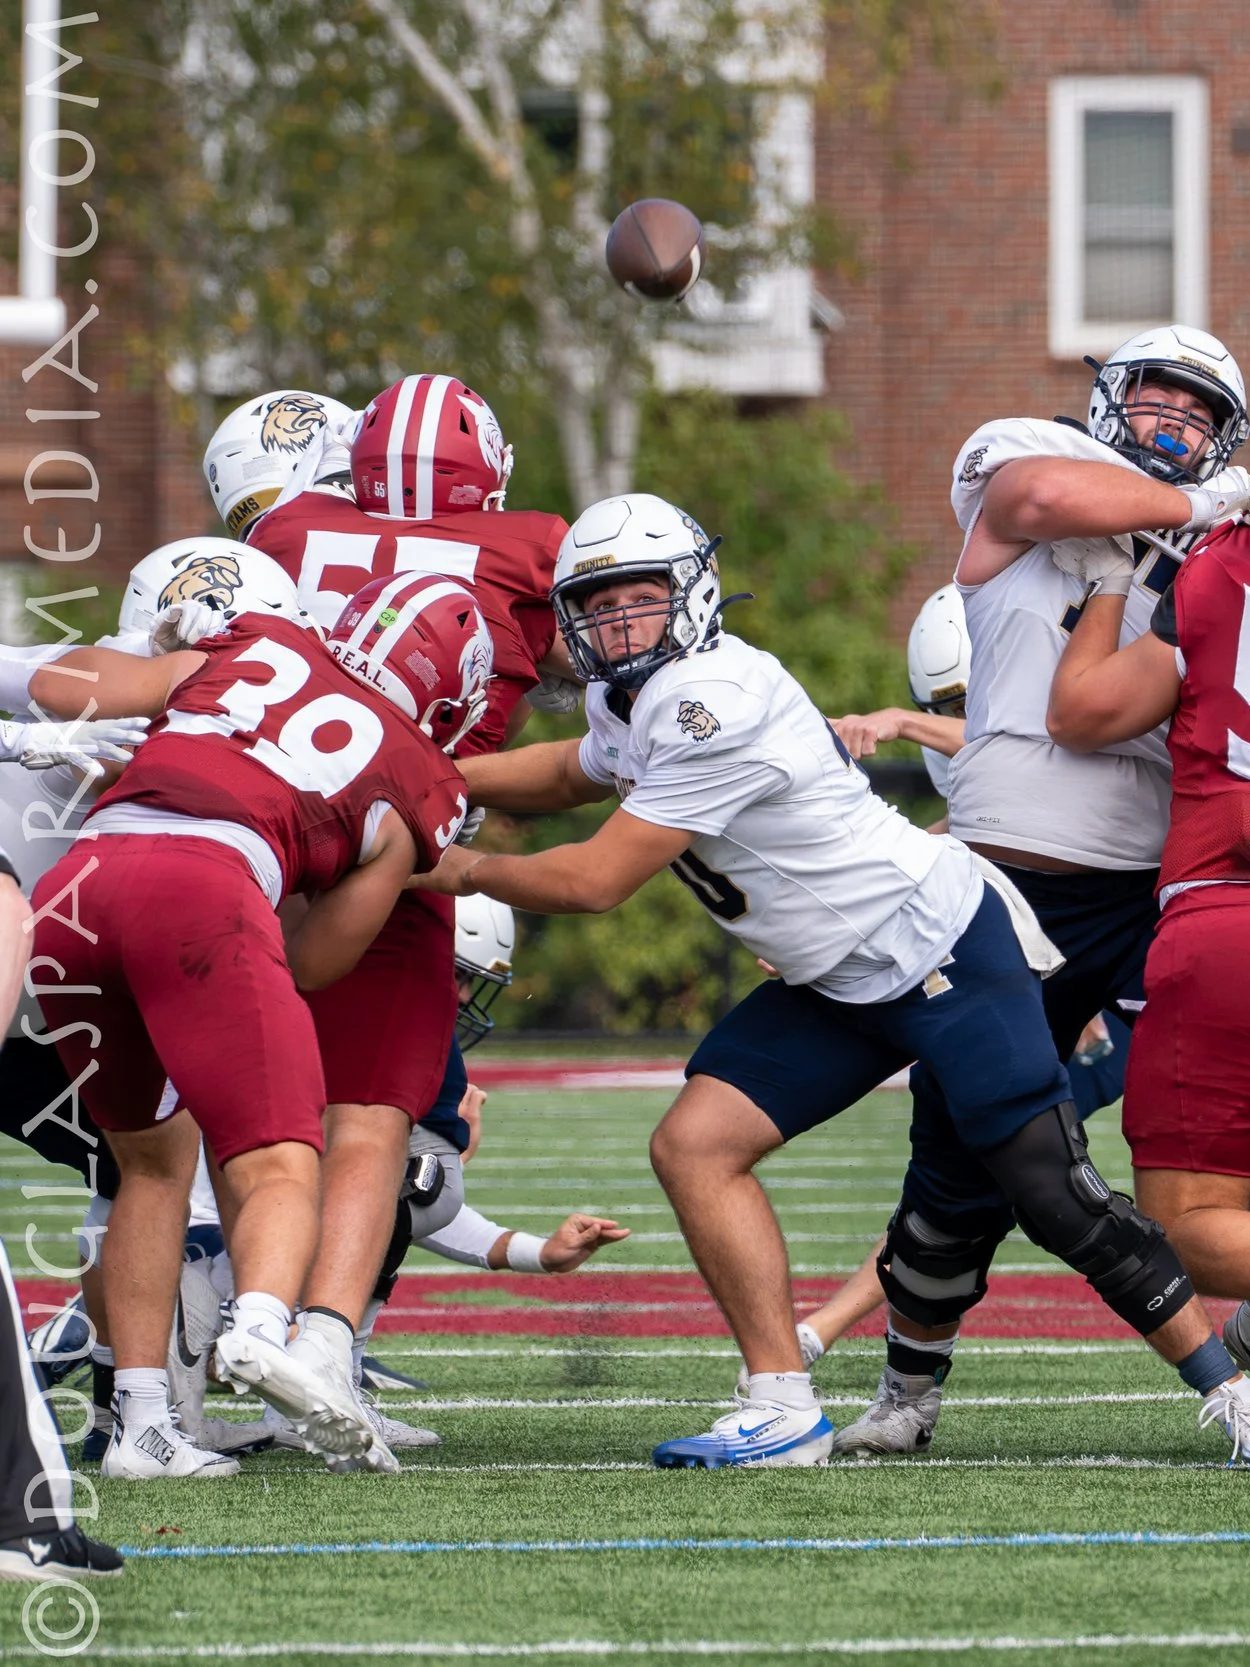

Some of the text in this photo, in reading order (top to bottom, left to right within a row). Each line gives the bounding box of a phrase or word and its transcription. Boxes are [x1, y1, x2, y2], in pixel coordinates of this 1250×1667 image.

[374, 481, 386, 498] 55
[347, 610, 362, 628] 39
[380, 611, 396, 623] C2P
[332, 645, 386, 692] R.E.A.L.
[135, 1426, 176, 1466] NIKE
